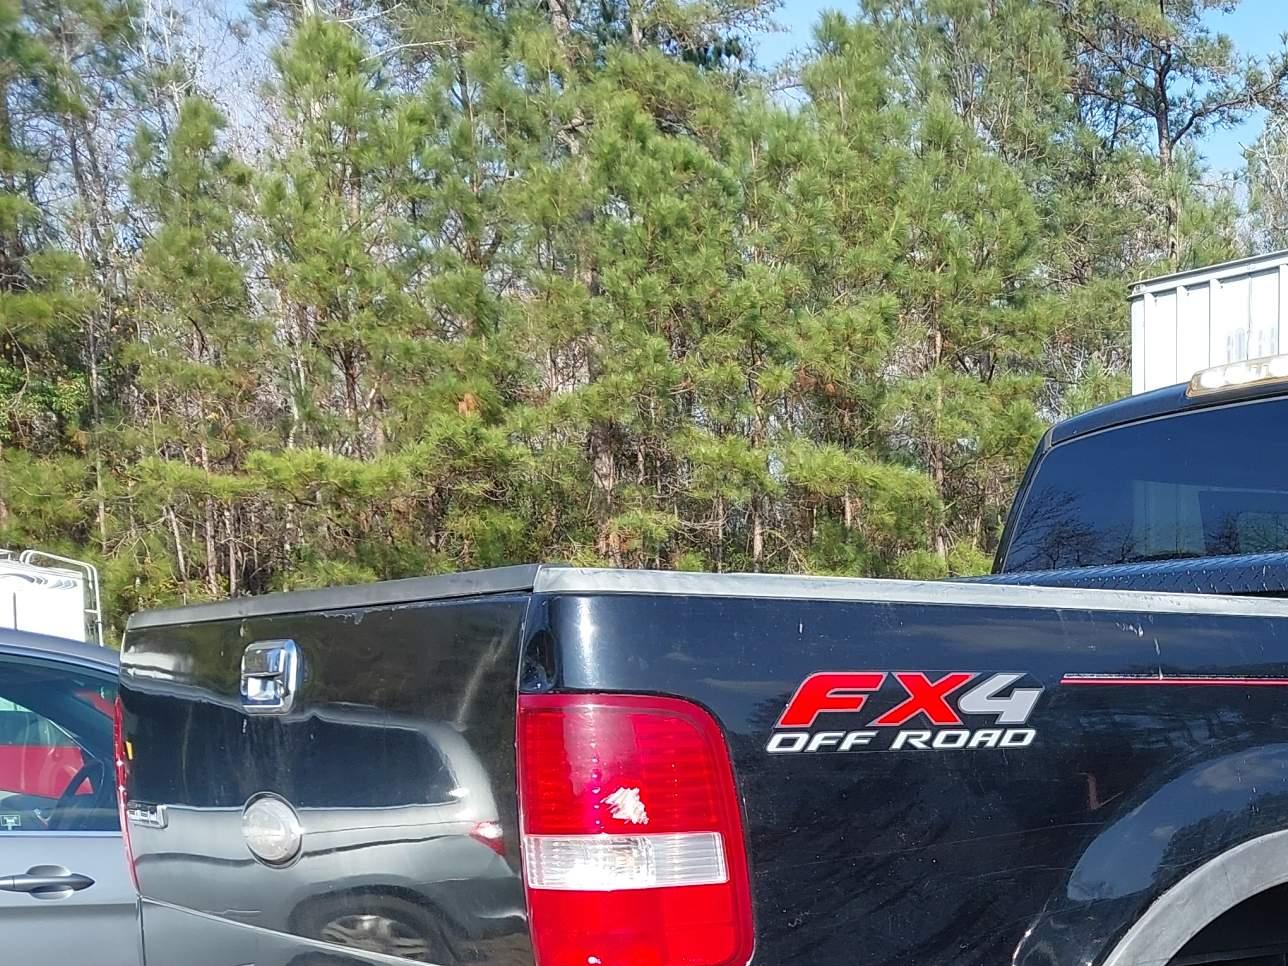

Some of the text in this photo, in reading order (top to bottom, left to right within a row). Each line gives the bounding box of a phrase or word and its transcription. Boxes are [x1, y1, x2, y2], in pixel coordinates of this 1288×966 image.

[776, 671, 1045, 728] FX4
[766, 728, 1037, 753] OFF ROAD
